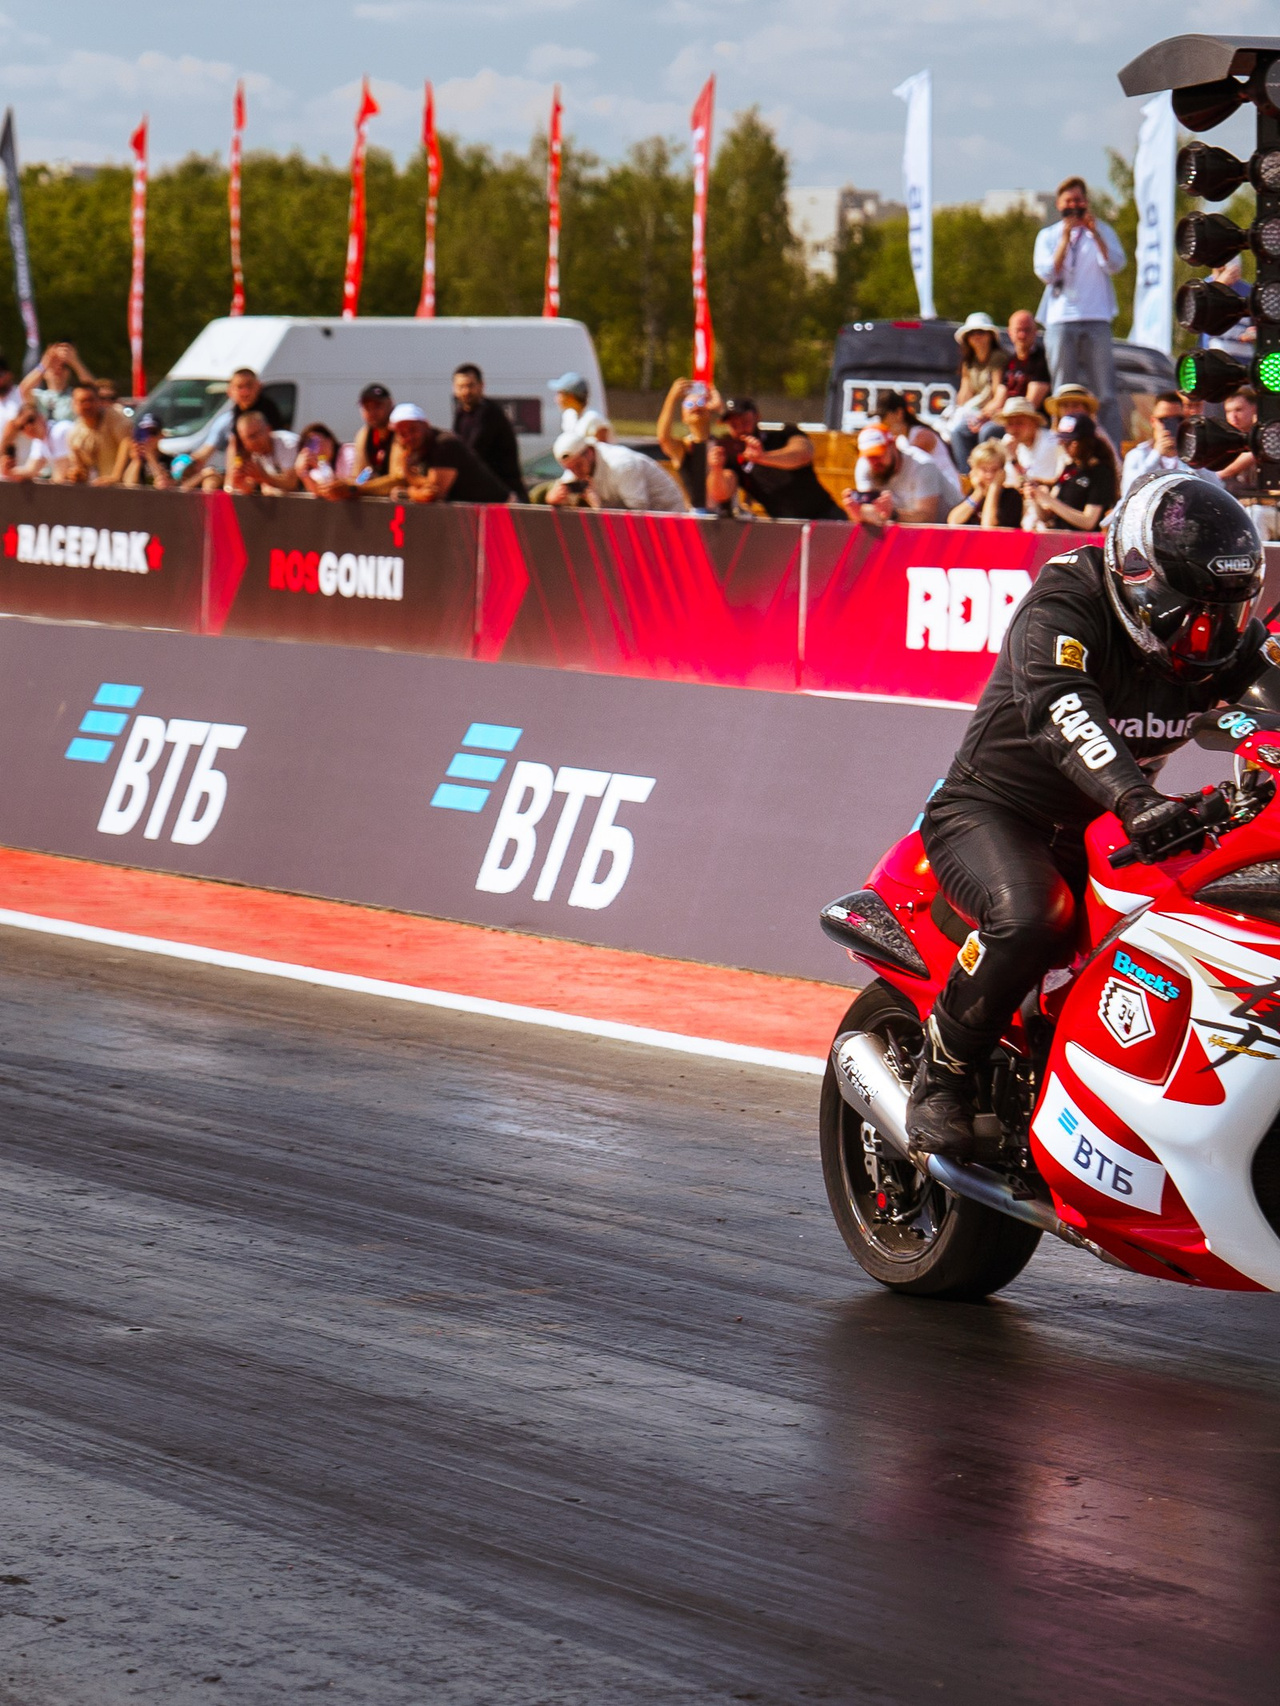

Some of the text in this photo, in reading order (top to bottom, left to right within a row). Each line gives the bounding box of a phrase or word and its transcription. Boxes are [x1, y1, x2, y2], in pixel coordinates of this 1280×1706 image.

[17, 524, 149, 574] RACEPARK
[269, 549, 403, 600] ROSGONKI
[906, 567, 1033, 653] RDR
[1049, 692, 1117, 770] RAPID
[97, 715, 247, 845] ВТБ
[475, 760, 656, 910] ВТБ
[1112, 950, 1180, 999] Brock's
[1073, 1134, 1134, 1195] ВТБ
